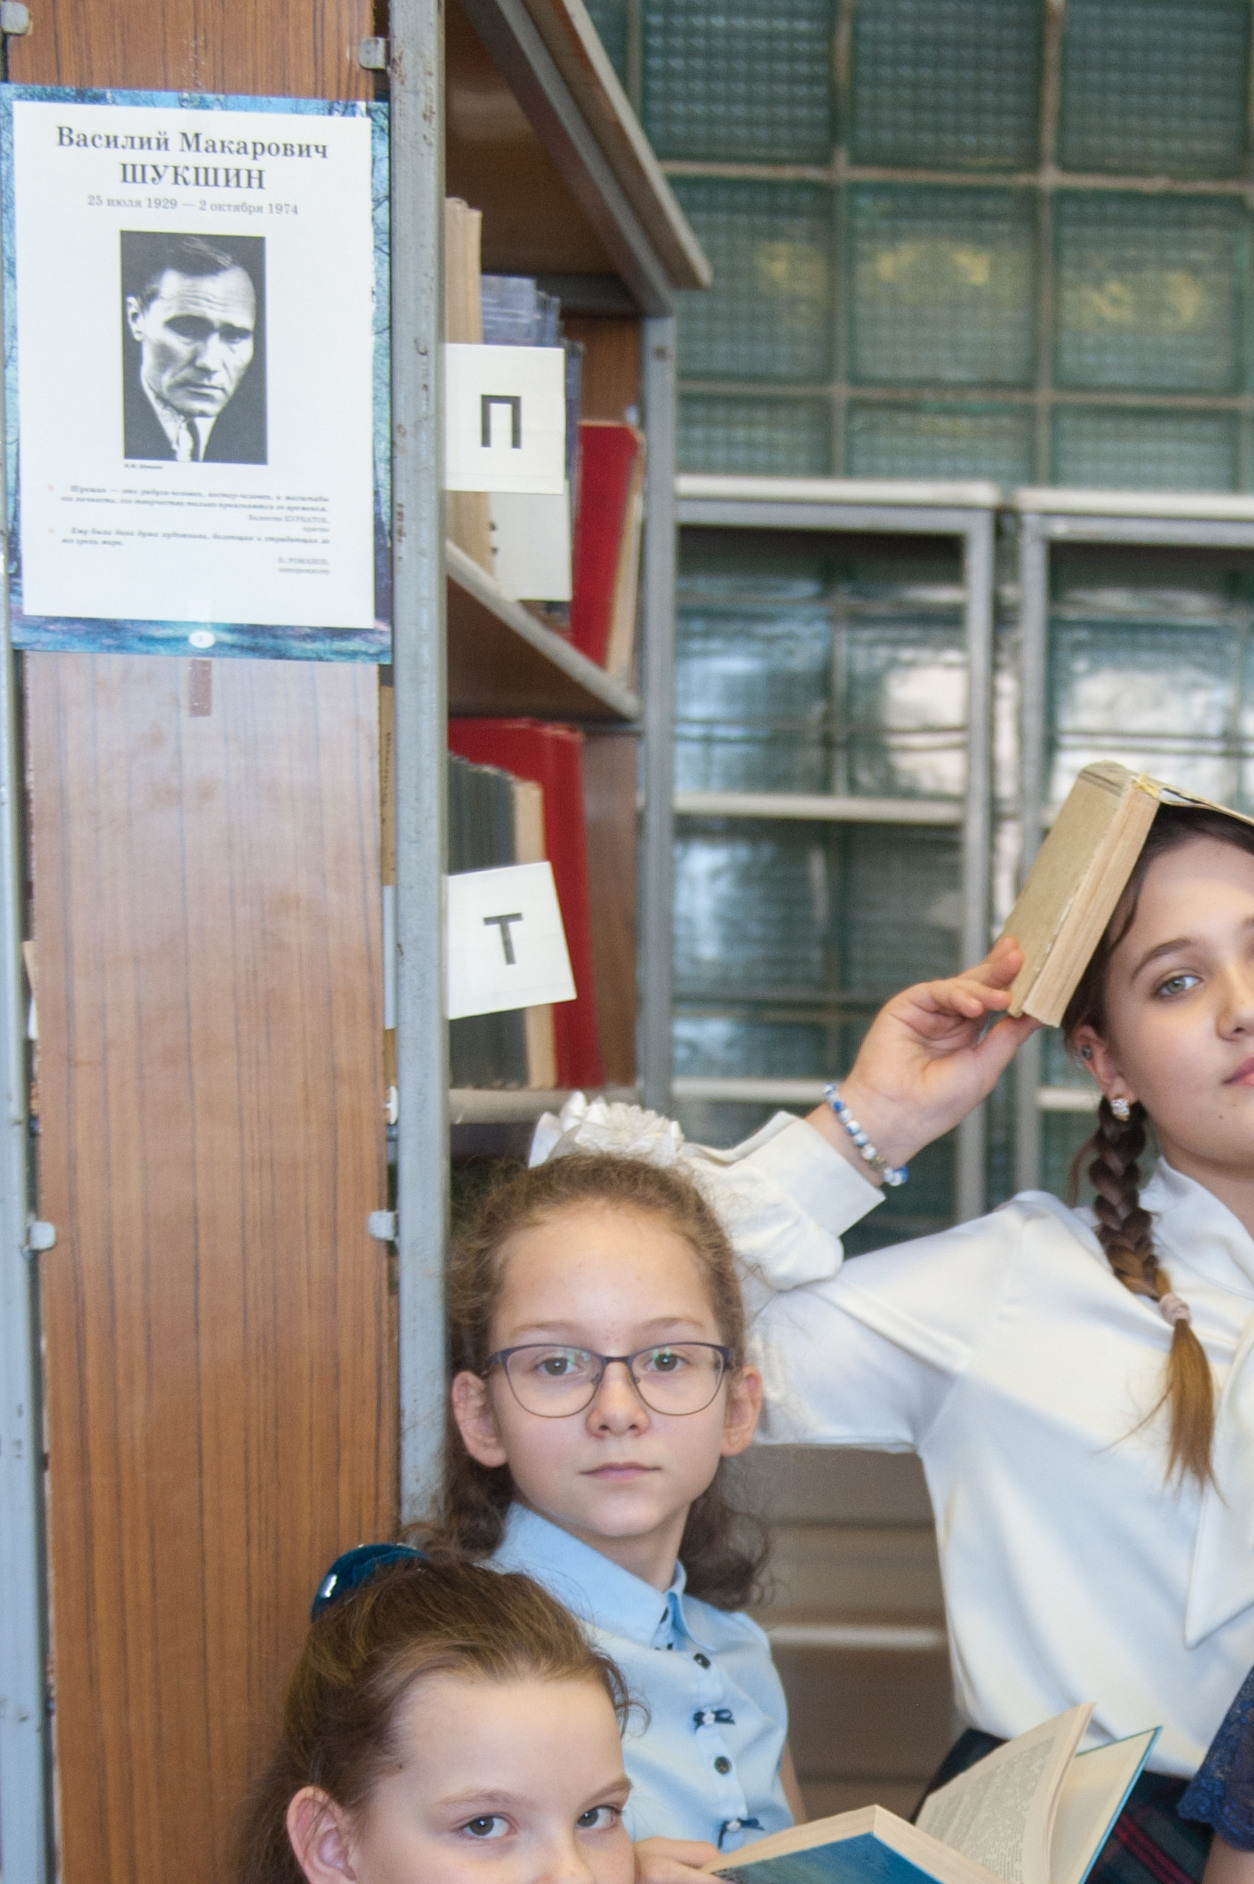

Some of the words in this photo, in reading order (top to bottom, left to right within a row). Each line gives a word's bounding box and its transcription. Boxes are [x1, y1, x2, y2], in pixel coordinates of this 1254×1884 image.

[56, 125, 170, 152] Василий
[178, 131, 329, 160] Макарович
[119, 162, 266, 190] ШУКШИН
[87, 194, 103, 207] 25
[106, 198, 142, 208] июля
[147, 197, 178, 210] 1929
[198, 200, 207, 212] 2
[210, 202, 264, 215] октября
[268, 203, 299, 215] 1974
[480, 394, 521, 449] П
[483, 912, 523, 965] Т
